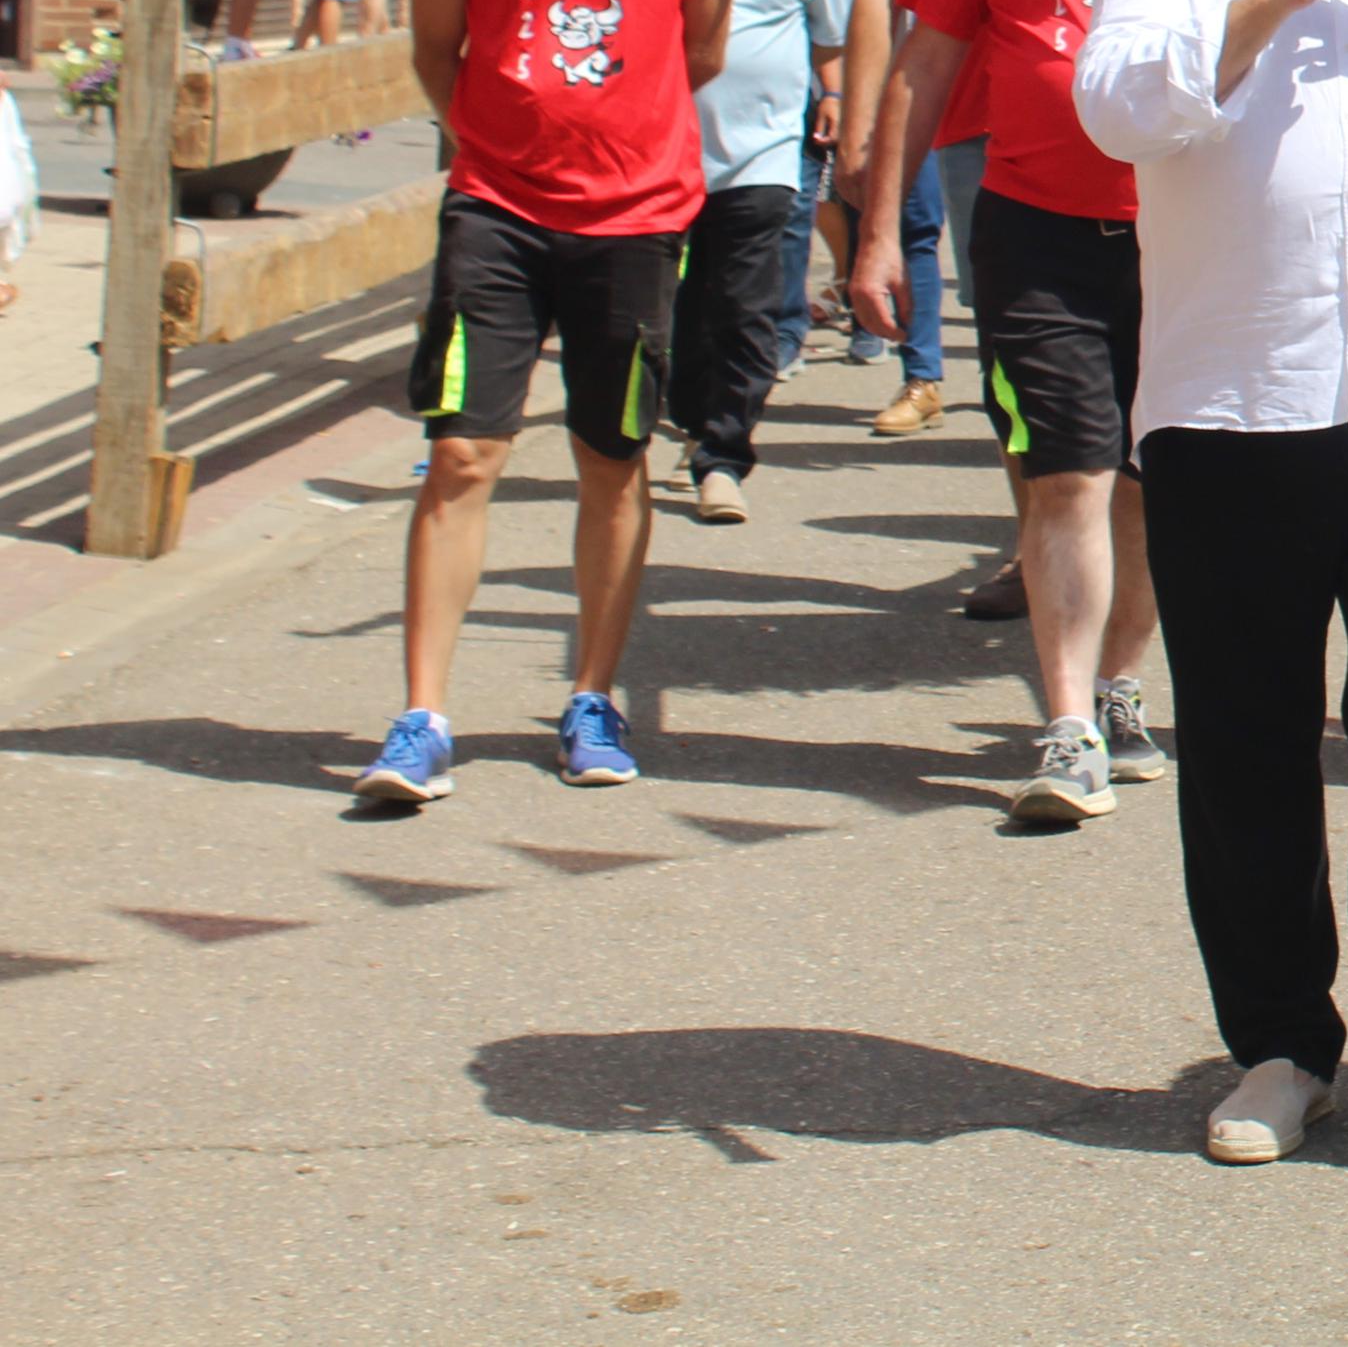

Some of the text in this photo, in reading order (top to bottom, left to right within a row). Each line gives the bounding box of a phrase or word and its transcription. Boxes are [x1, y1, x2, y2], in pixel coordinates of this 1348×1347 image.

[518, 11, 535, 40] 2
[1055, 27, 1068, 51] 5
[517, 53, 531, 79] 5
